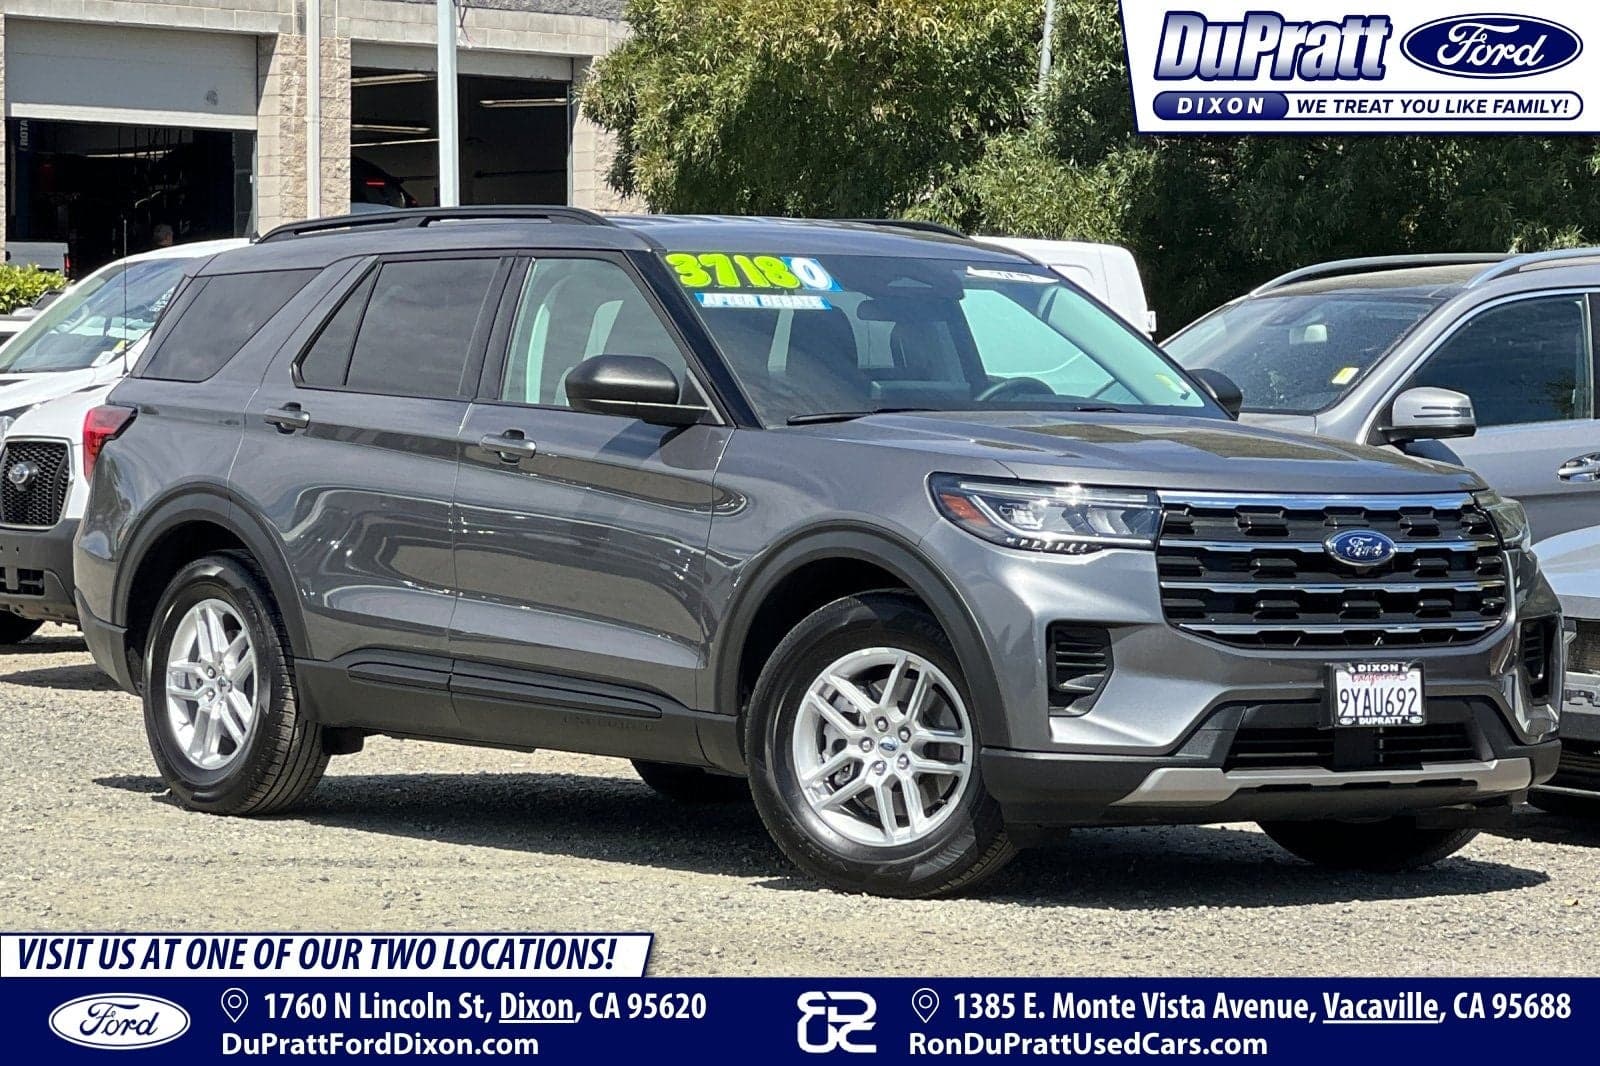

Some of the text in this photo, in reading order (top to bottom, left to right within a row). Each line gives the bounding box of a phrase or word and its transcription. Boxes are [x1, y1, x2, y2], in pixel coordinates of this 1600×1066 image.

[759, 295, 825, 310] REBATE
[1346, 537, 1383, 557] Ford
[1357, 663, 1399, 673] DIXON
[1339, 687, 1418, 717] 9YAU692
[1358, 716, 1403, 726] DUPRATT
